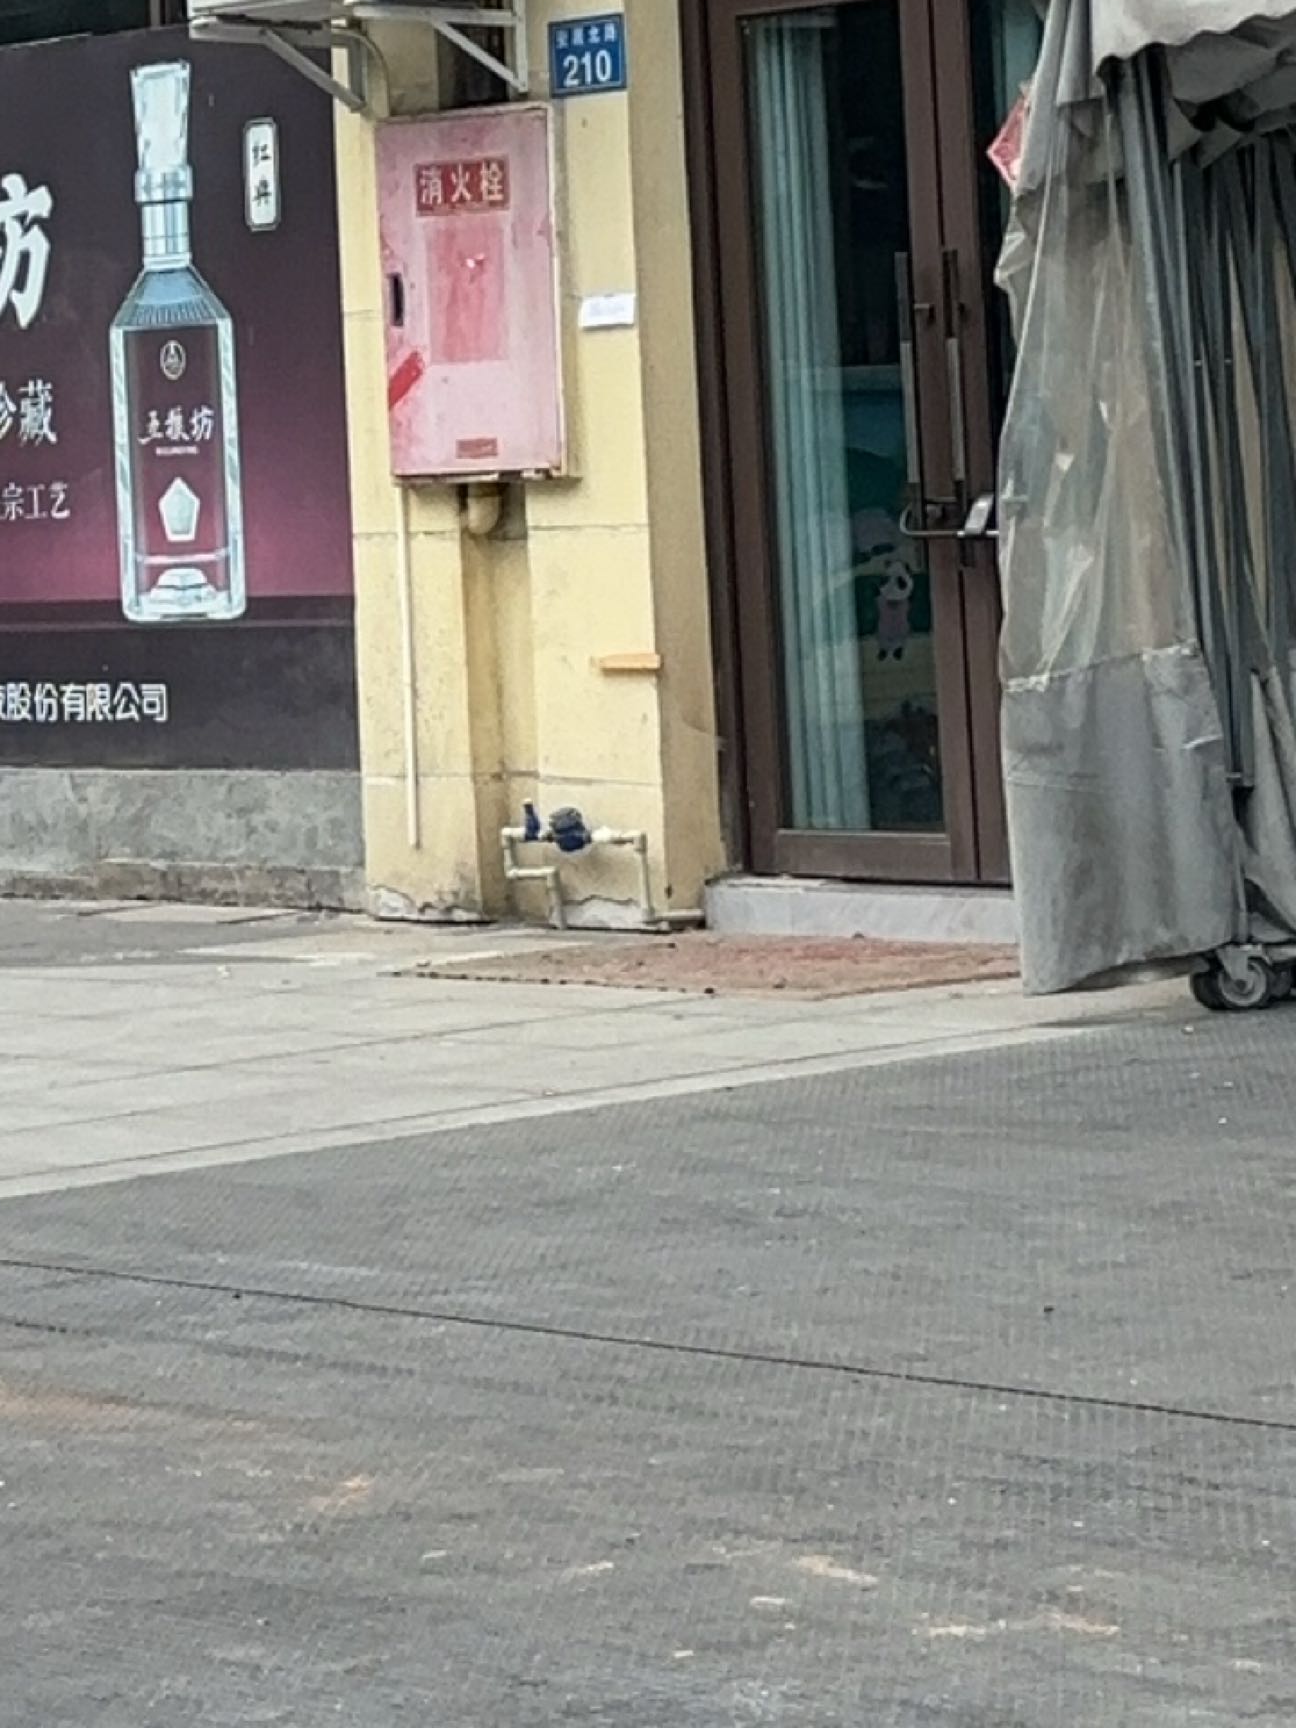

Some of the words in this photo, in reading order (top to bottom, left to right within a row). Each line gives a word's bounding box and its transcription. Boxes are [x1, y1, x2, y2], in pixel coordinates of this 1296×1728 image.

[563, 49, 612, 88] 210
[420, 158, 504, 205] 消火栓
